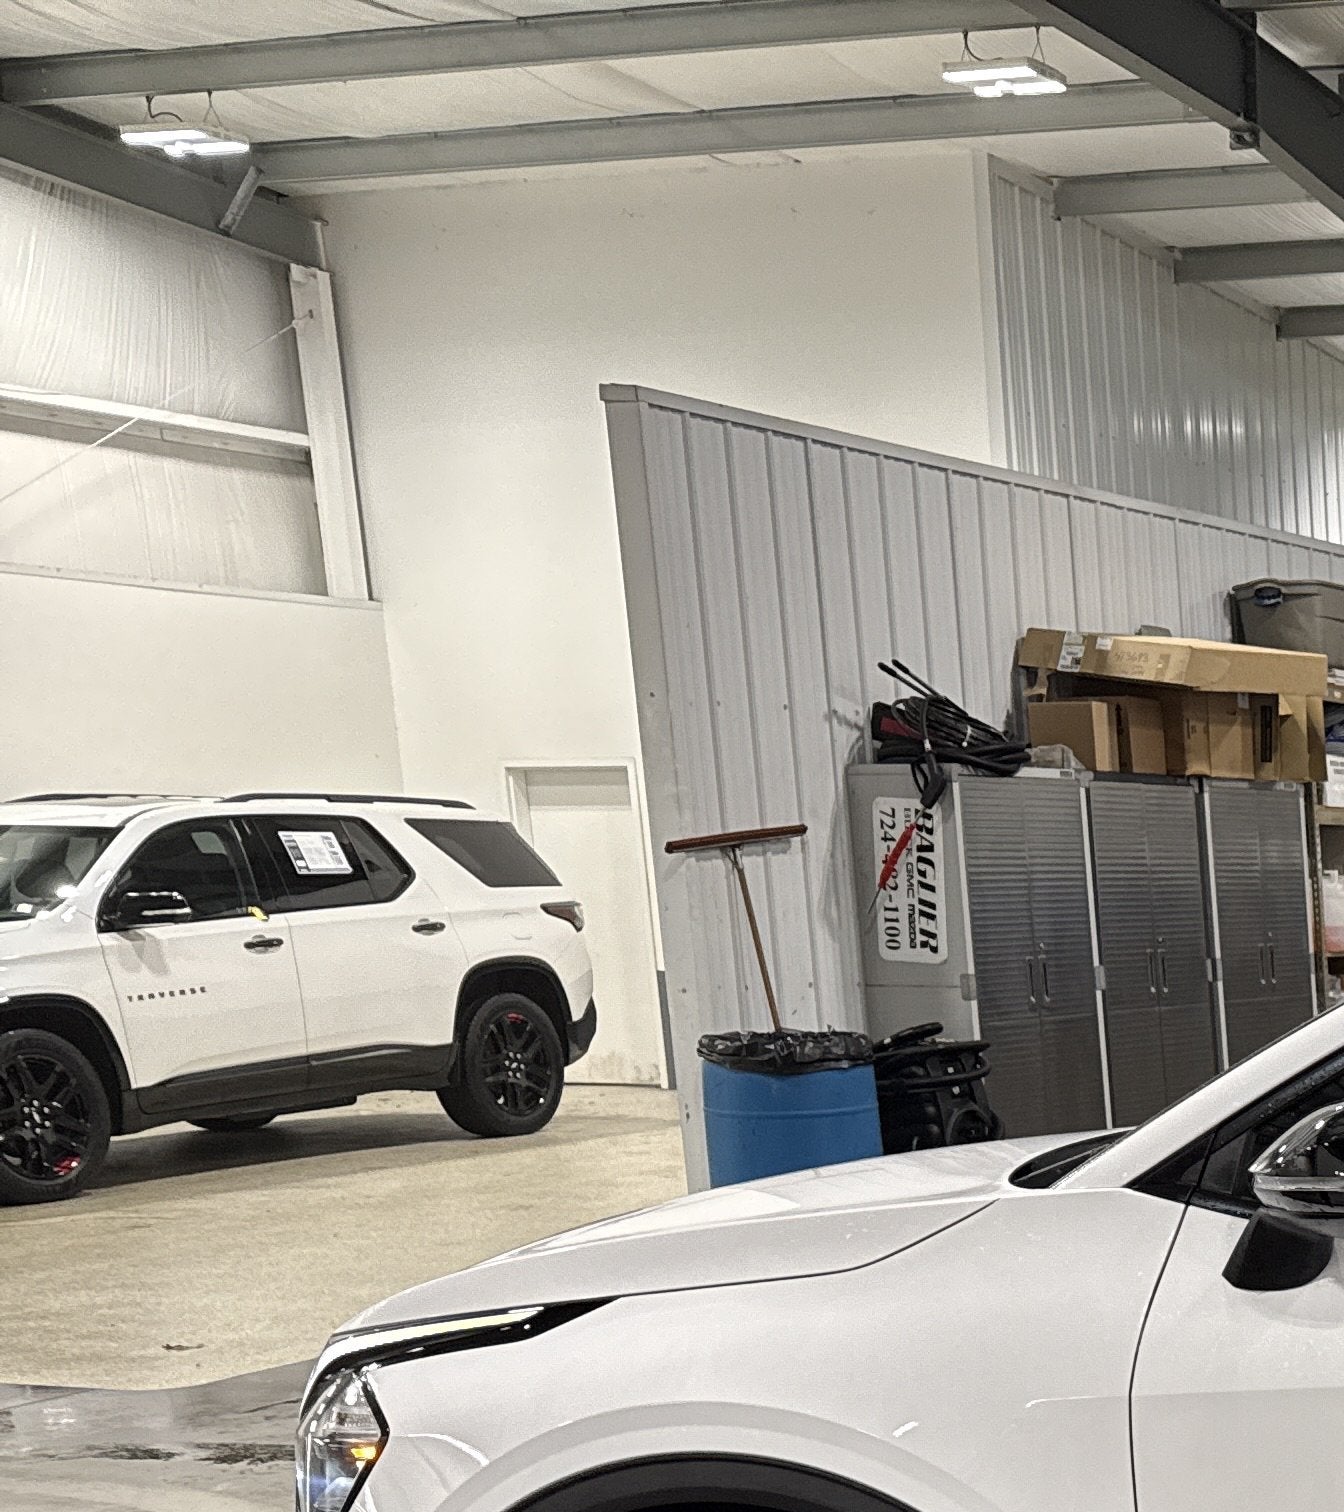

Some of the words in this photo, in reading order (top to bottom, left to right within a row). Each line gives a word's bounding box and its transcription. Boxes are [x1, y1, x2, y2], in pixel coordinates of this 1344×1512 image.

[906, 862, 915, 899] GMC
[914, 808, 939, 954] BAGLIER
[127, 986, 207, 1002] TRAVERSE
